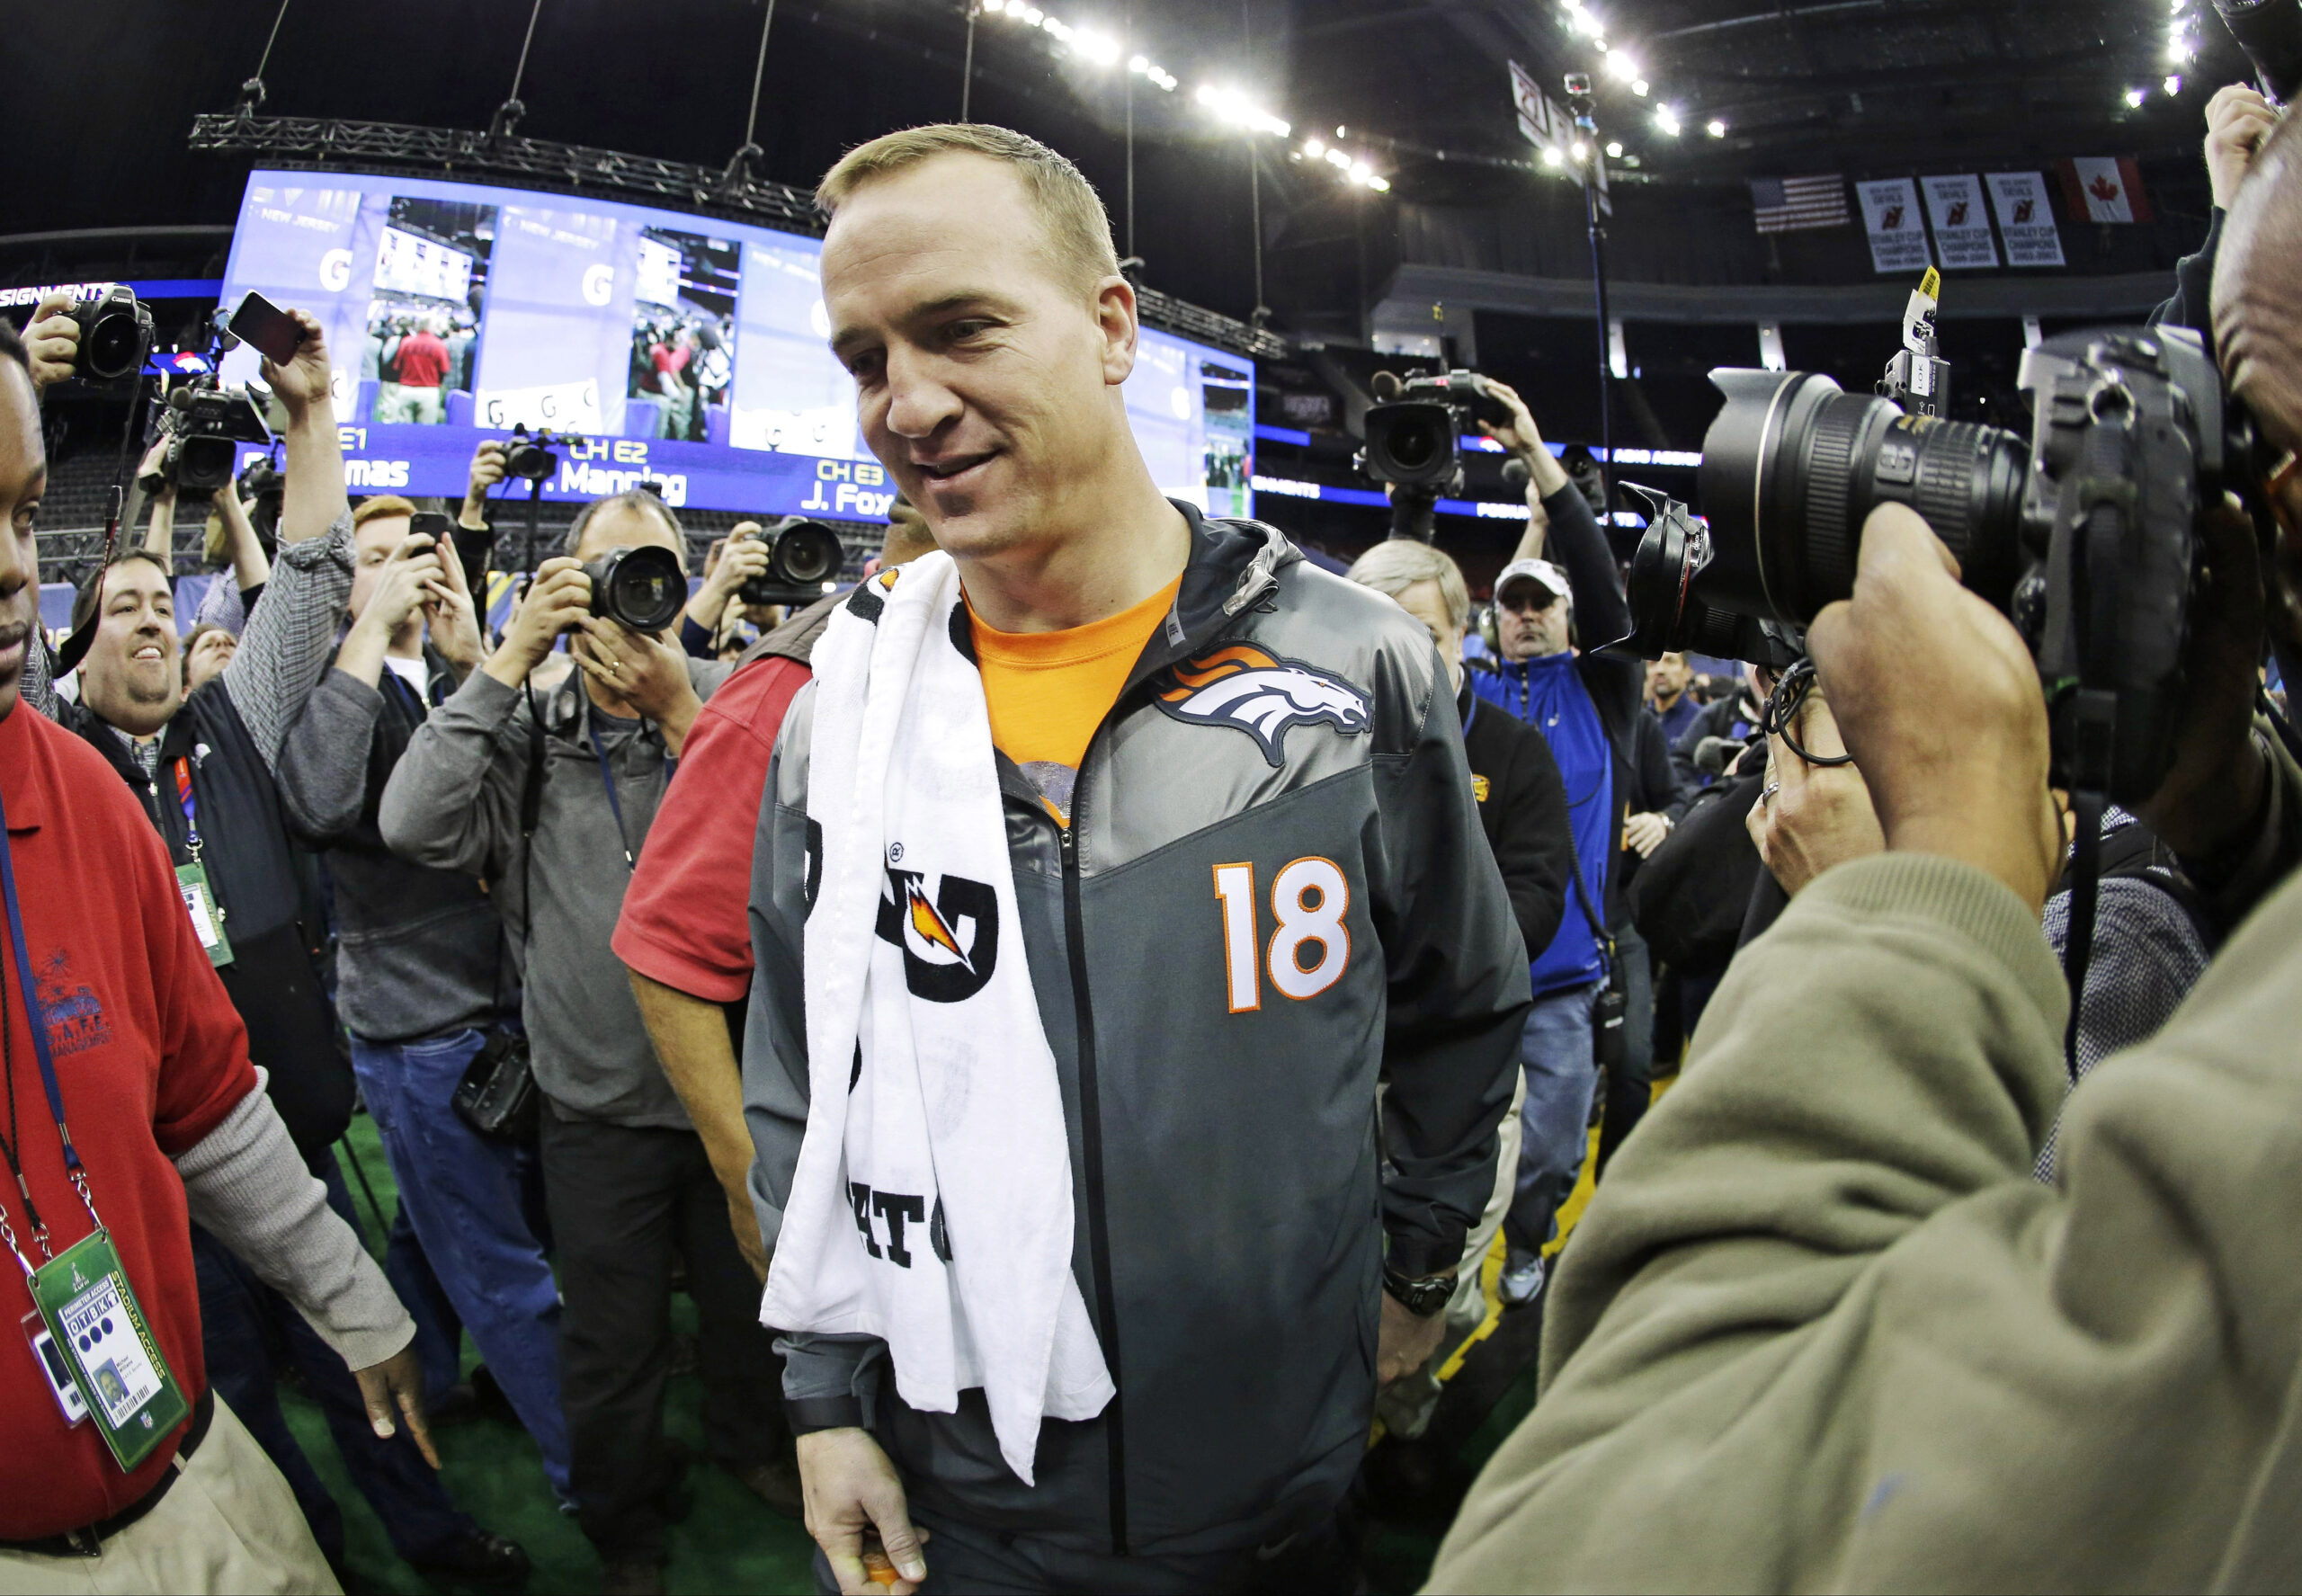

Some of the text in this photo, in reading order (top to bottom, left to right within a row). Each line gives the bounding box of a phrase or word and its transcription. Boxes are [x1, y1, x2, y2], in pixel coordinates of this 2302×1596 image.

[111, 296, 132, 304] Canon
[613, 440, 649, 464] E2
[816, 459, 885, 486] CH E3
[800, 479, 896, 516] J. Fox
[1212, 855, 1352, 1014] 18
[64, 1279, 110, 1318] PERIMETER ACCESS
[111, 1271, 141, 1330] STADIUM
[138, 1331, 165, 1379] ACCESS
